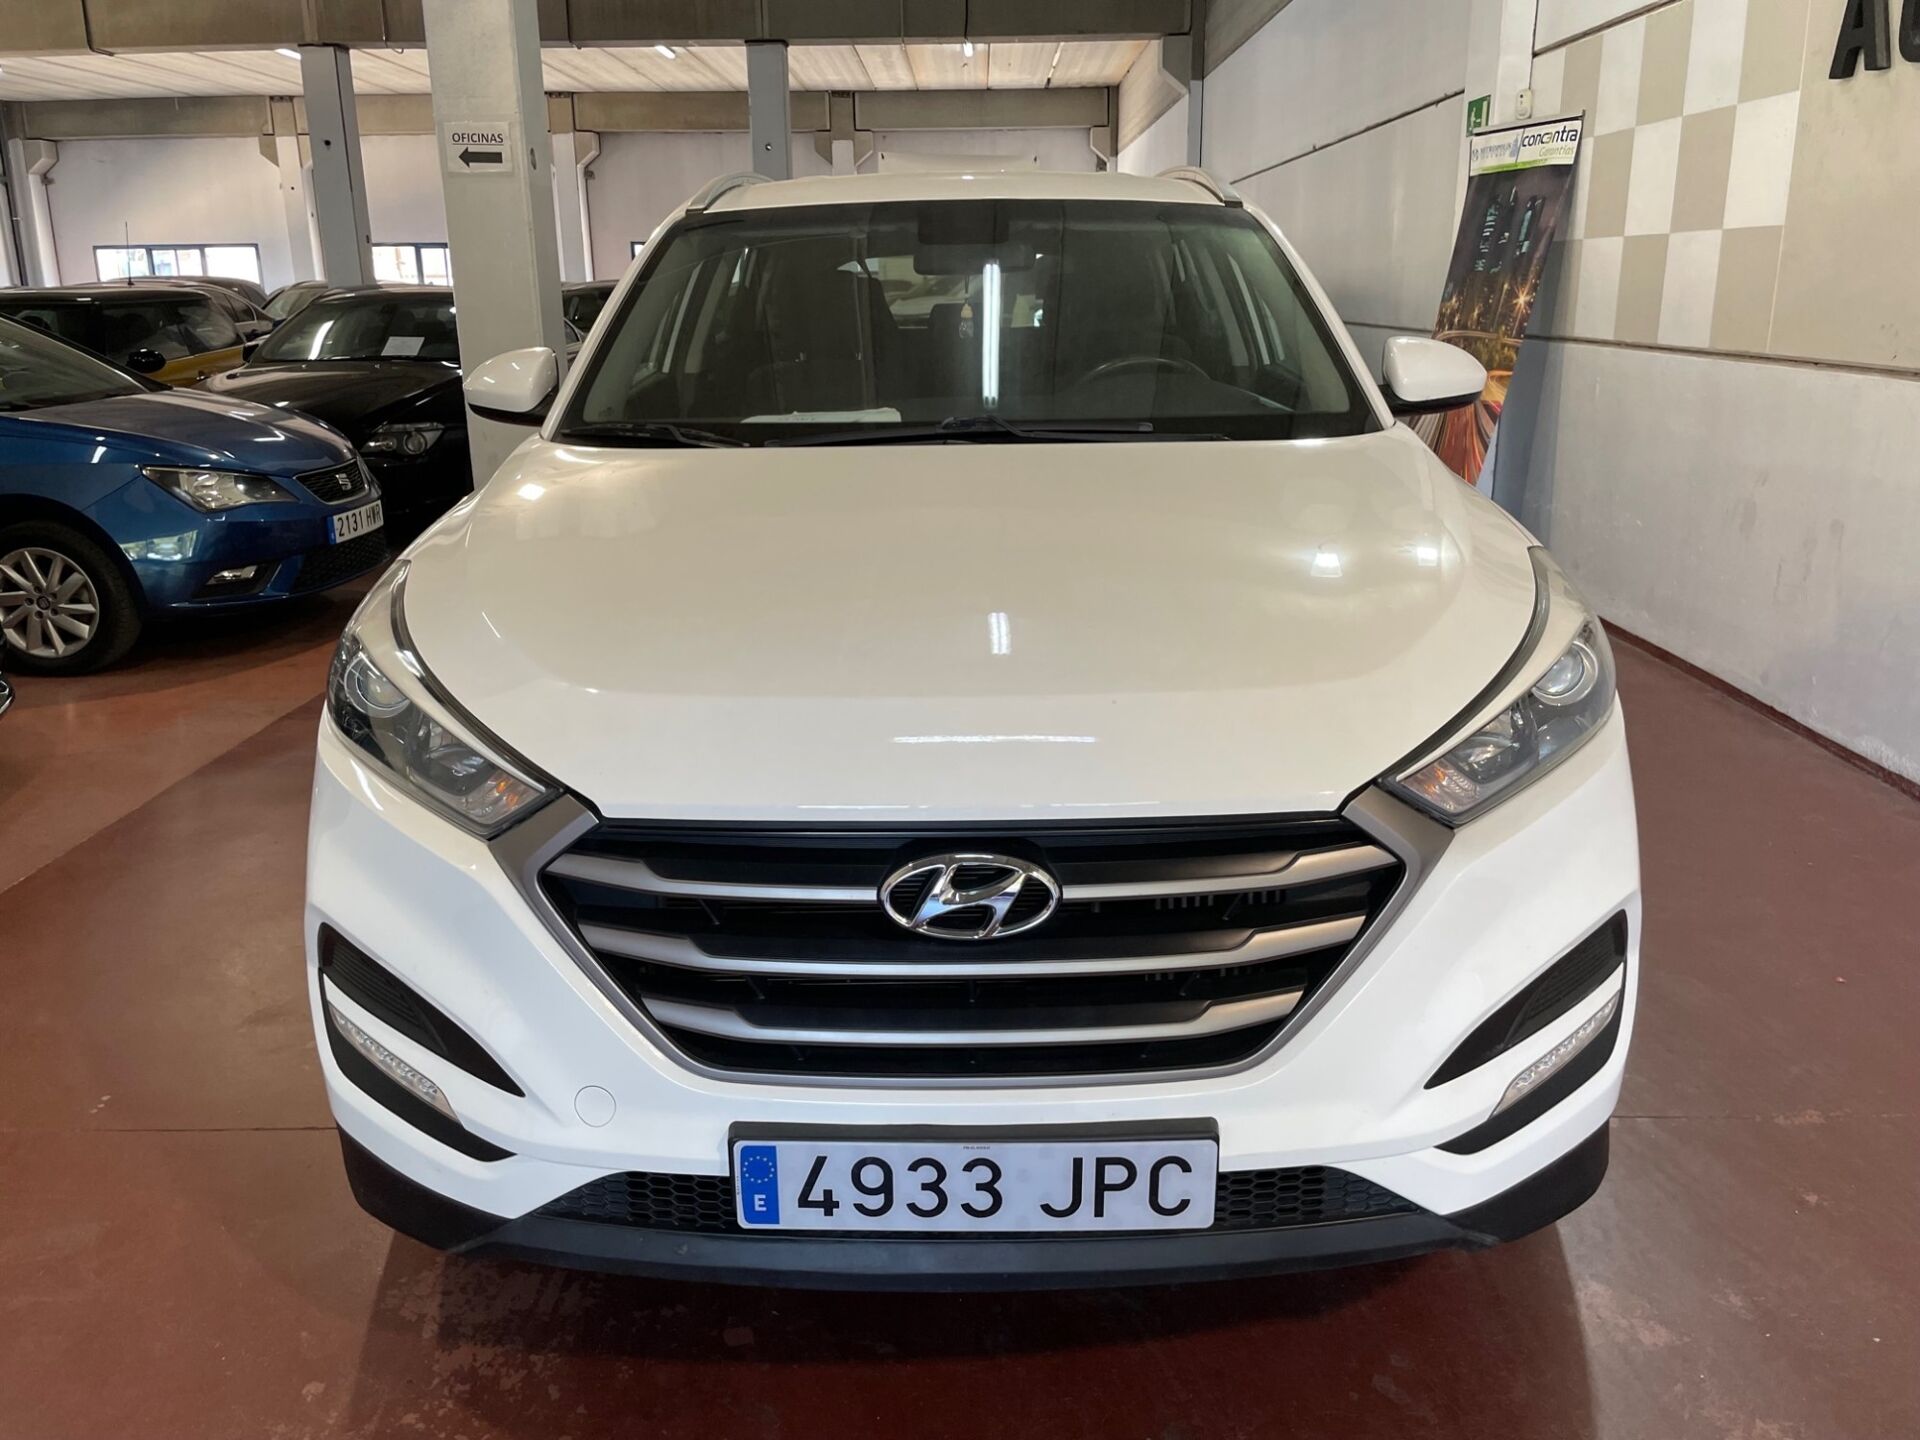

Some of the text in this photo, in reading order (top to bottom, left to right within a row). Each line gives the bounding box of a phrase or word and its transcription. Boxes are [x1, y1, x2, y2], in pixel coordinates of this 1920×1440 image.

[452, 132, 504, 143] OFICINAS
[337, 511, 363, 537] 2131
[754, 1155, 1192, 1218] E 4933 JPC
